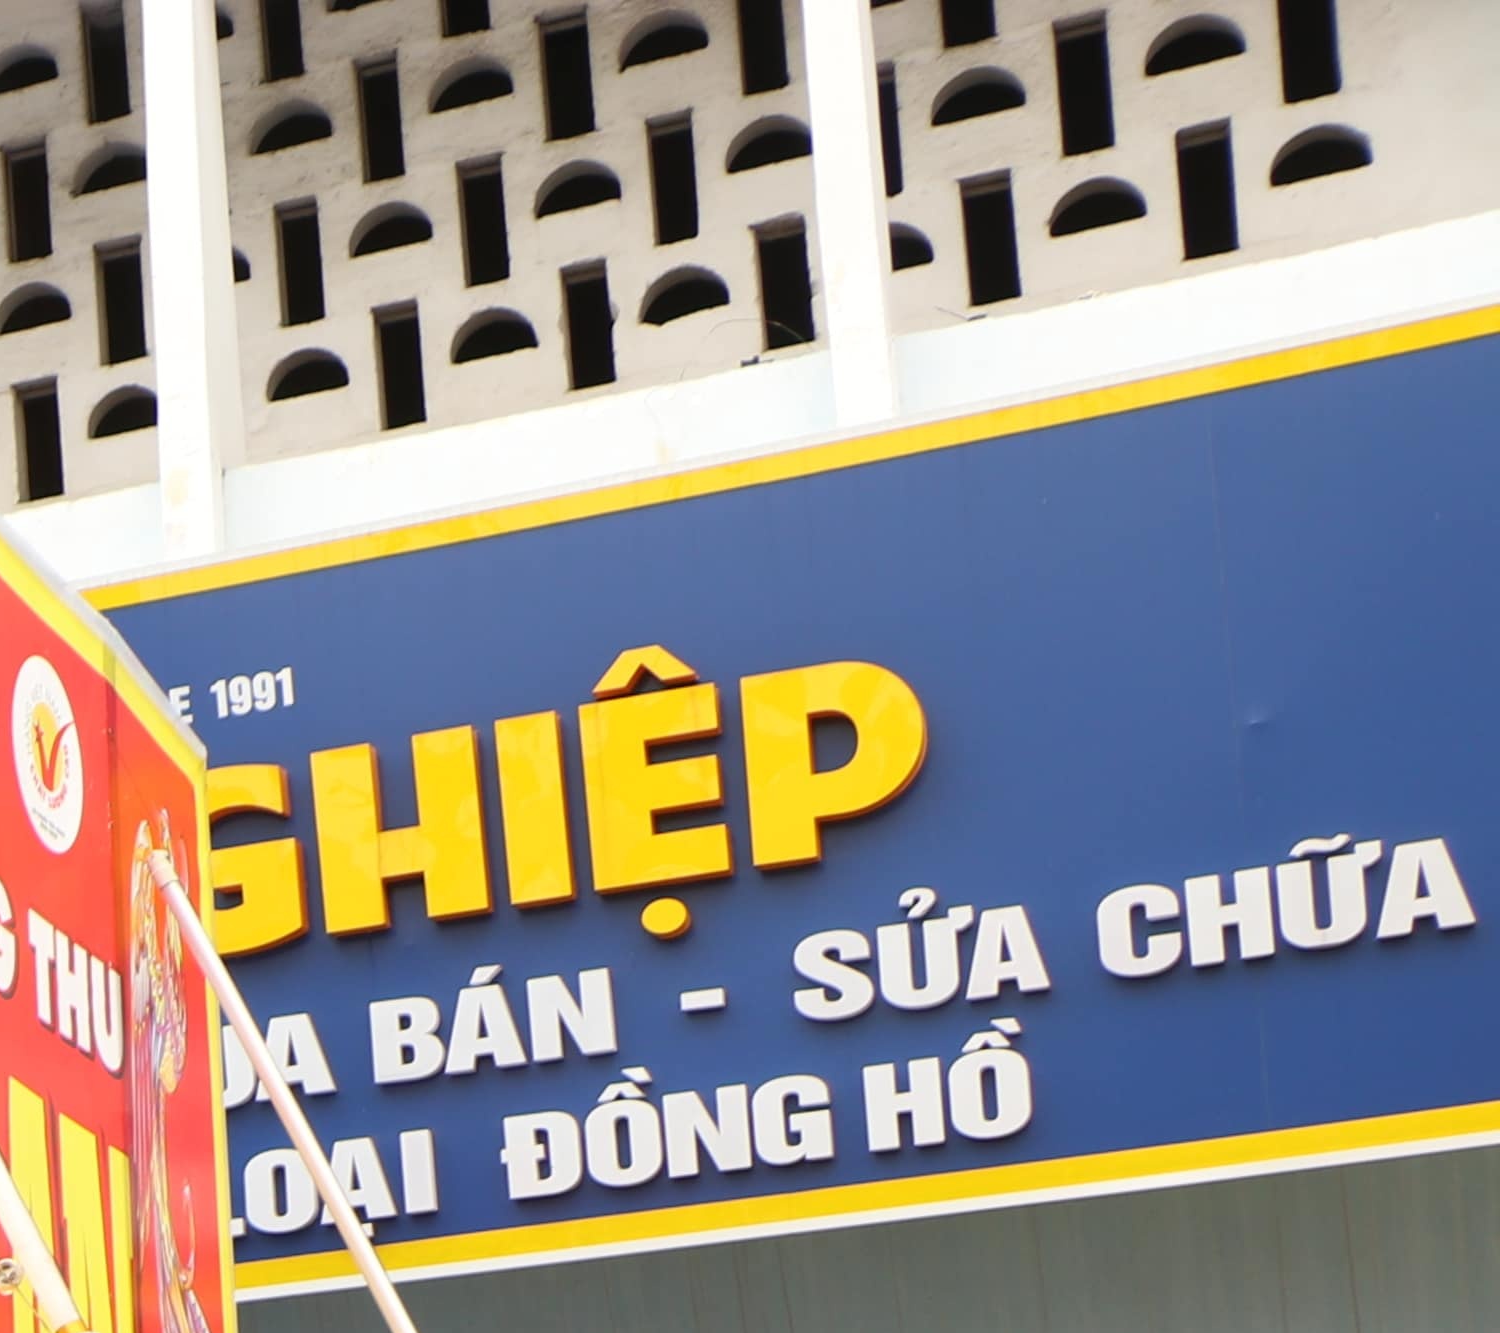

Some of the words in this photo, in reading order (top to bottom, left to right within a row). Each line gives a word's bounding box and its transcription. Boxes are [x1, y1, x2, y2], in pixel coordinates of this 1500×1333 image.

[209, 666, 296, 720] 1991
[28, 908, 124, 1074] THU
[367, 964, 619, 1085] BÁN
[793, 886, 1052, 1023] SỬA
[1096, 833, 1477, 979] CHỮA
[232, 1128, 440, 1240] OẠI
[500, 1066, 836, 1201] ĐỒNG
[863, 1016, 1033, 1153] HỒ
